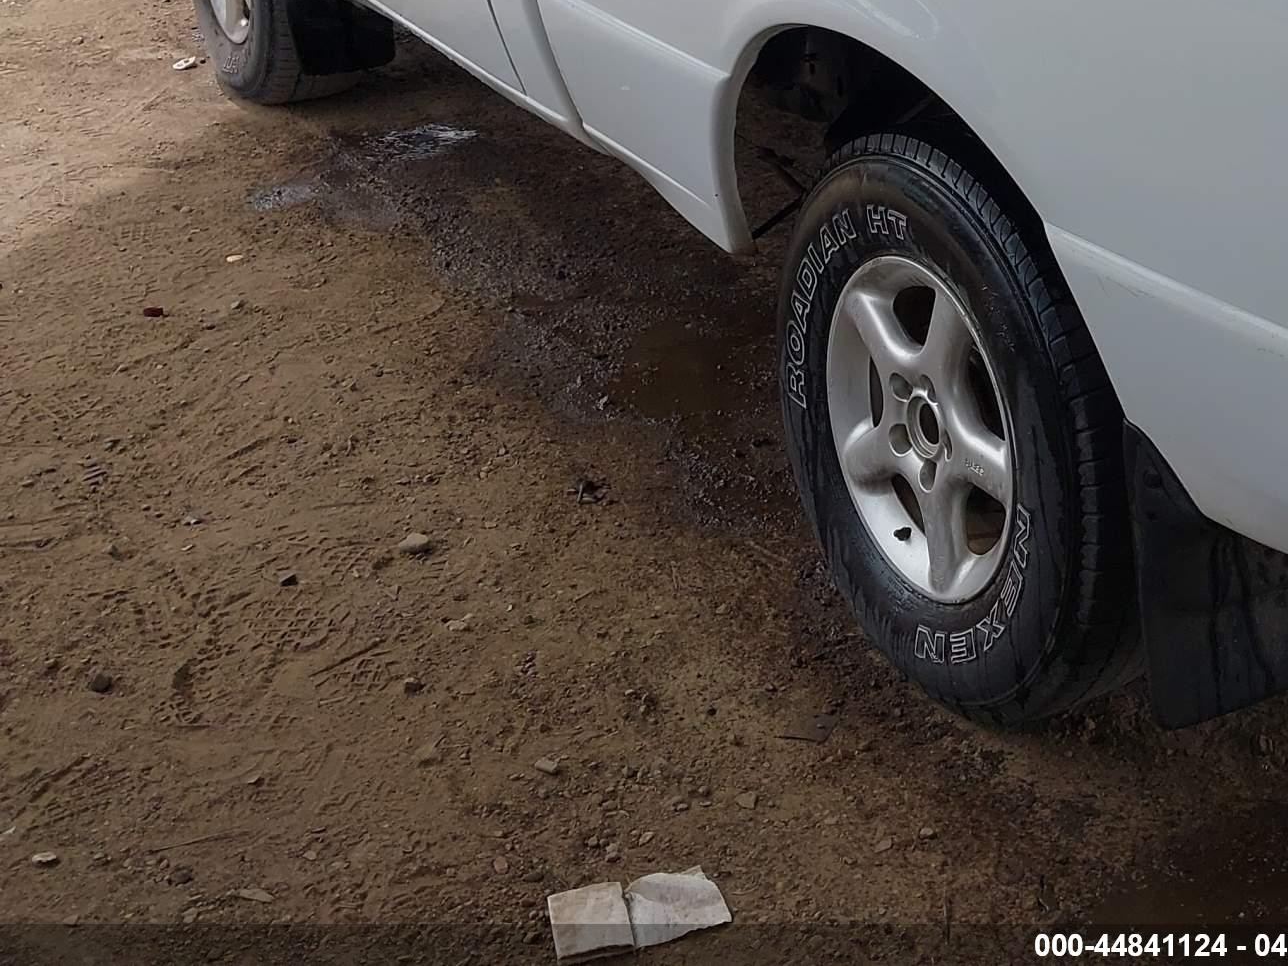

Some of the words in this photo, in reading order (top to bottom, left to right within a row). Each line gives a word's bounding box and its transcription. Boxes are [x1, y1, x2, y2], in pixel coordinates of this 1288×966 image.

[786, 208, 858, 409] ROADIAN
[866, 204, 908, 241] HT
[914, 502, 1031, 664] NEXEN
